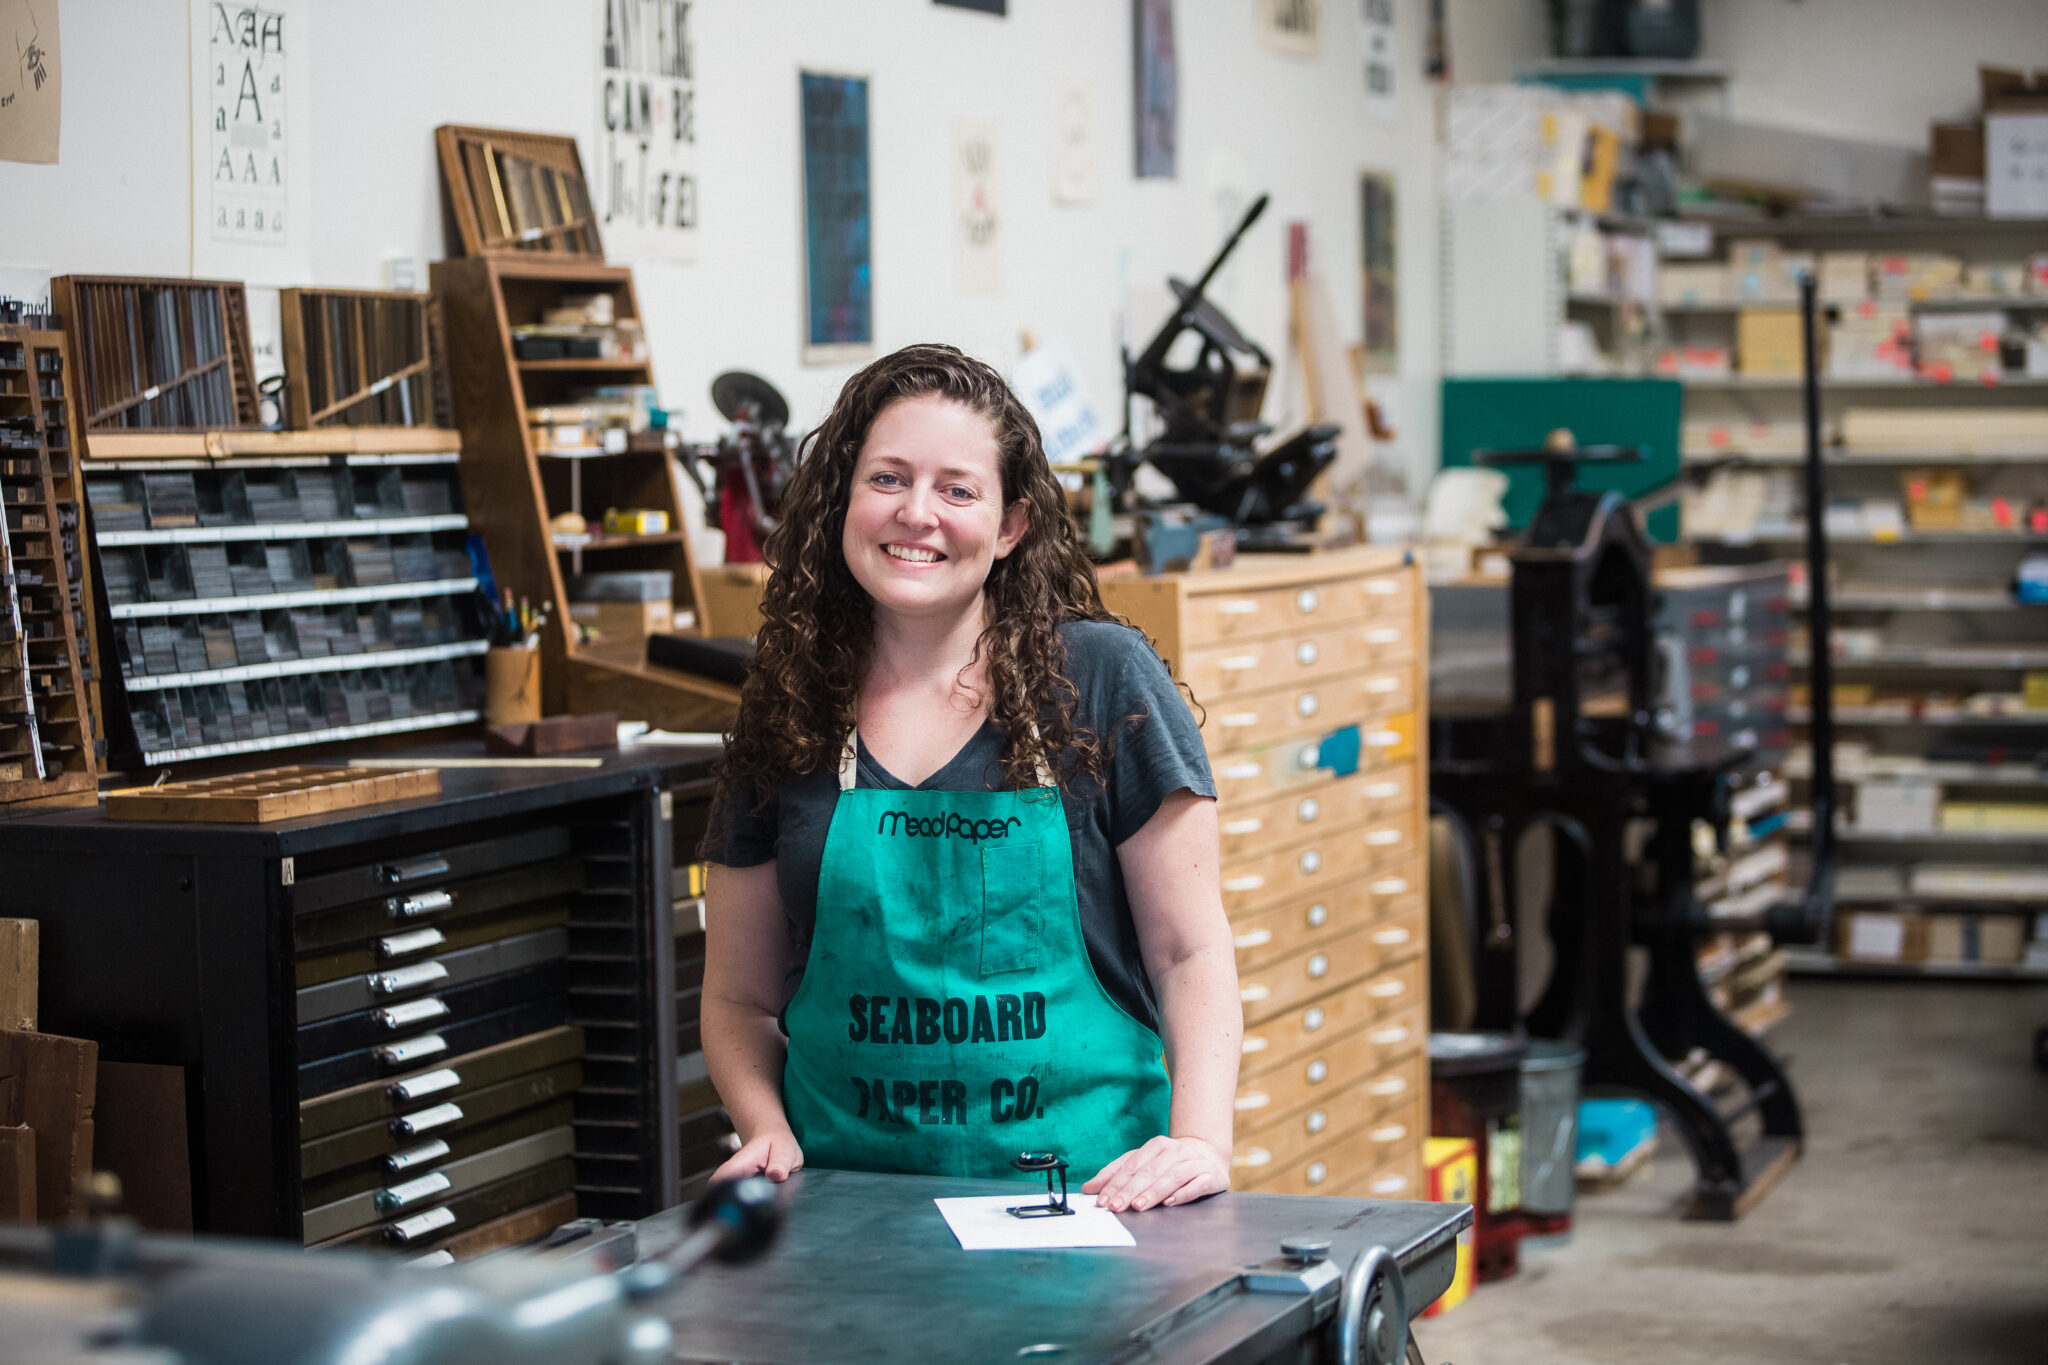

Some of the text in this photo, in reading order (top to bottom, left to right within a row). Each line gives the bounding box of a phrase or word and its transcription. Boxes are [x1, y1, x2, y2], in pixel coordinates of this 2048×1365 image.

[235, 56, 262, 124] A
[848, 991, 1047, 1045] SEABOARD
[990, 1075, 1045, 1124] CO.
